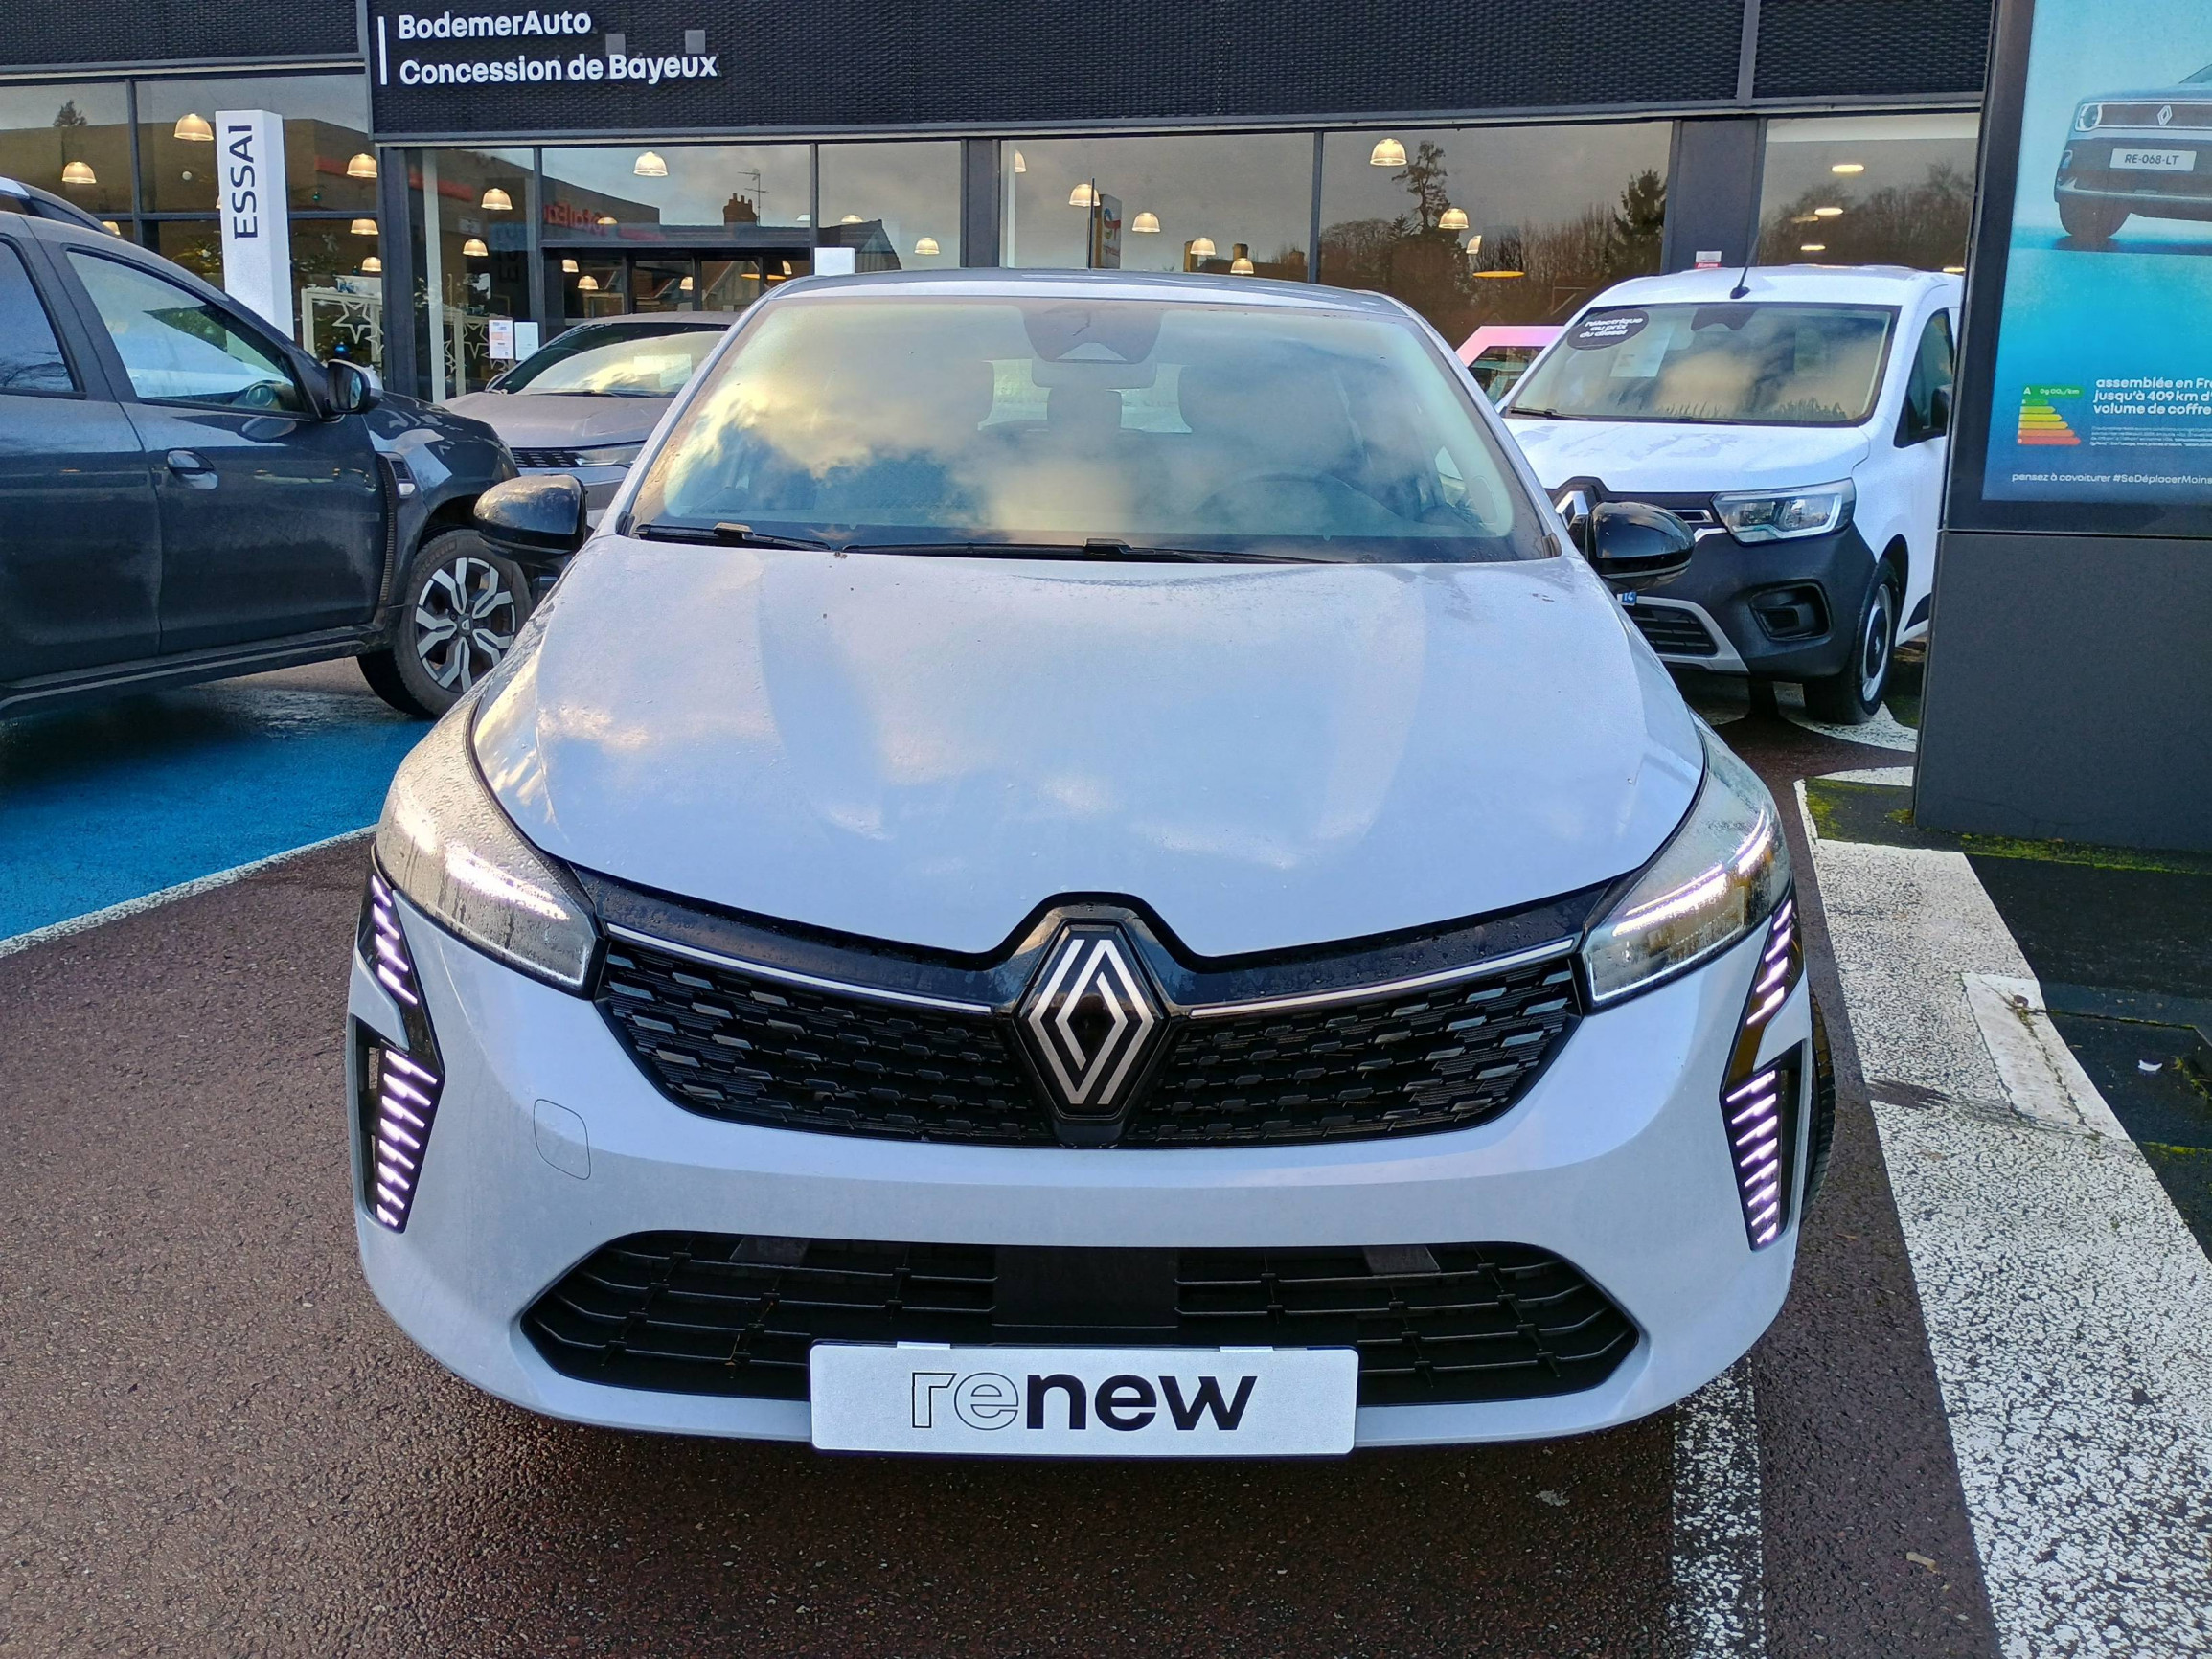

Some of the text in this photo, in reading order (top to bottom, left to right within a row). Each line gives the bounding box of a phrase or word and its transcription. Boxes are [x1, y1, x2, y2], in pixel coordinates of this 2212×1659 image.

[398, 10, 592, 40] BodemerAuto
[399, 53, 718, 85] Concession de Bayeux
[2125, 154, 2180, 165] RE-068-LT
[228, 125, 258, 239] ESSAI
[2095, 376, 2174, 388] assemblée
[2175, 379, 2194, 388] en
[2023, 386, 2031, 395] A
[2092, 390, 2146, 403] jusqu'à
[2146, 390, 2175, 401] 409
[2176, 390, 2199, 401] km
[2092, 402, 2212, 415] volume de coffre
[2059, 473, 2110, 482] covoiturer
[911, 1372, 1258, 1432] renew
